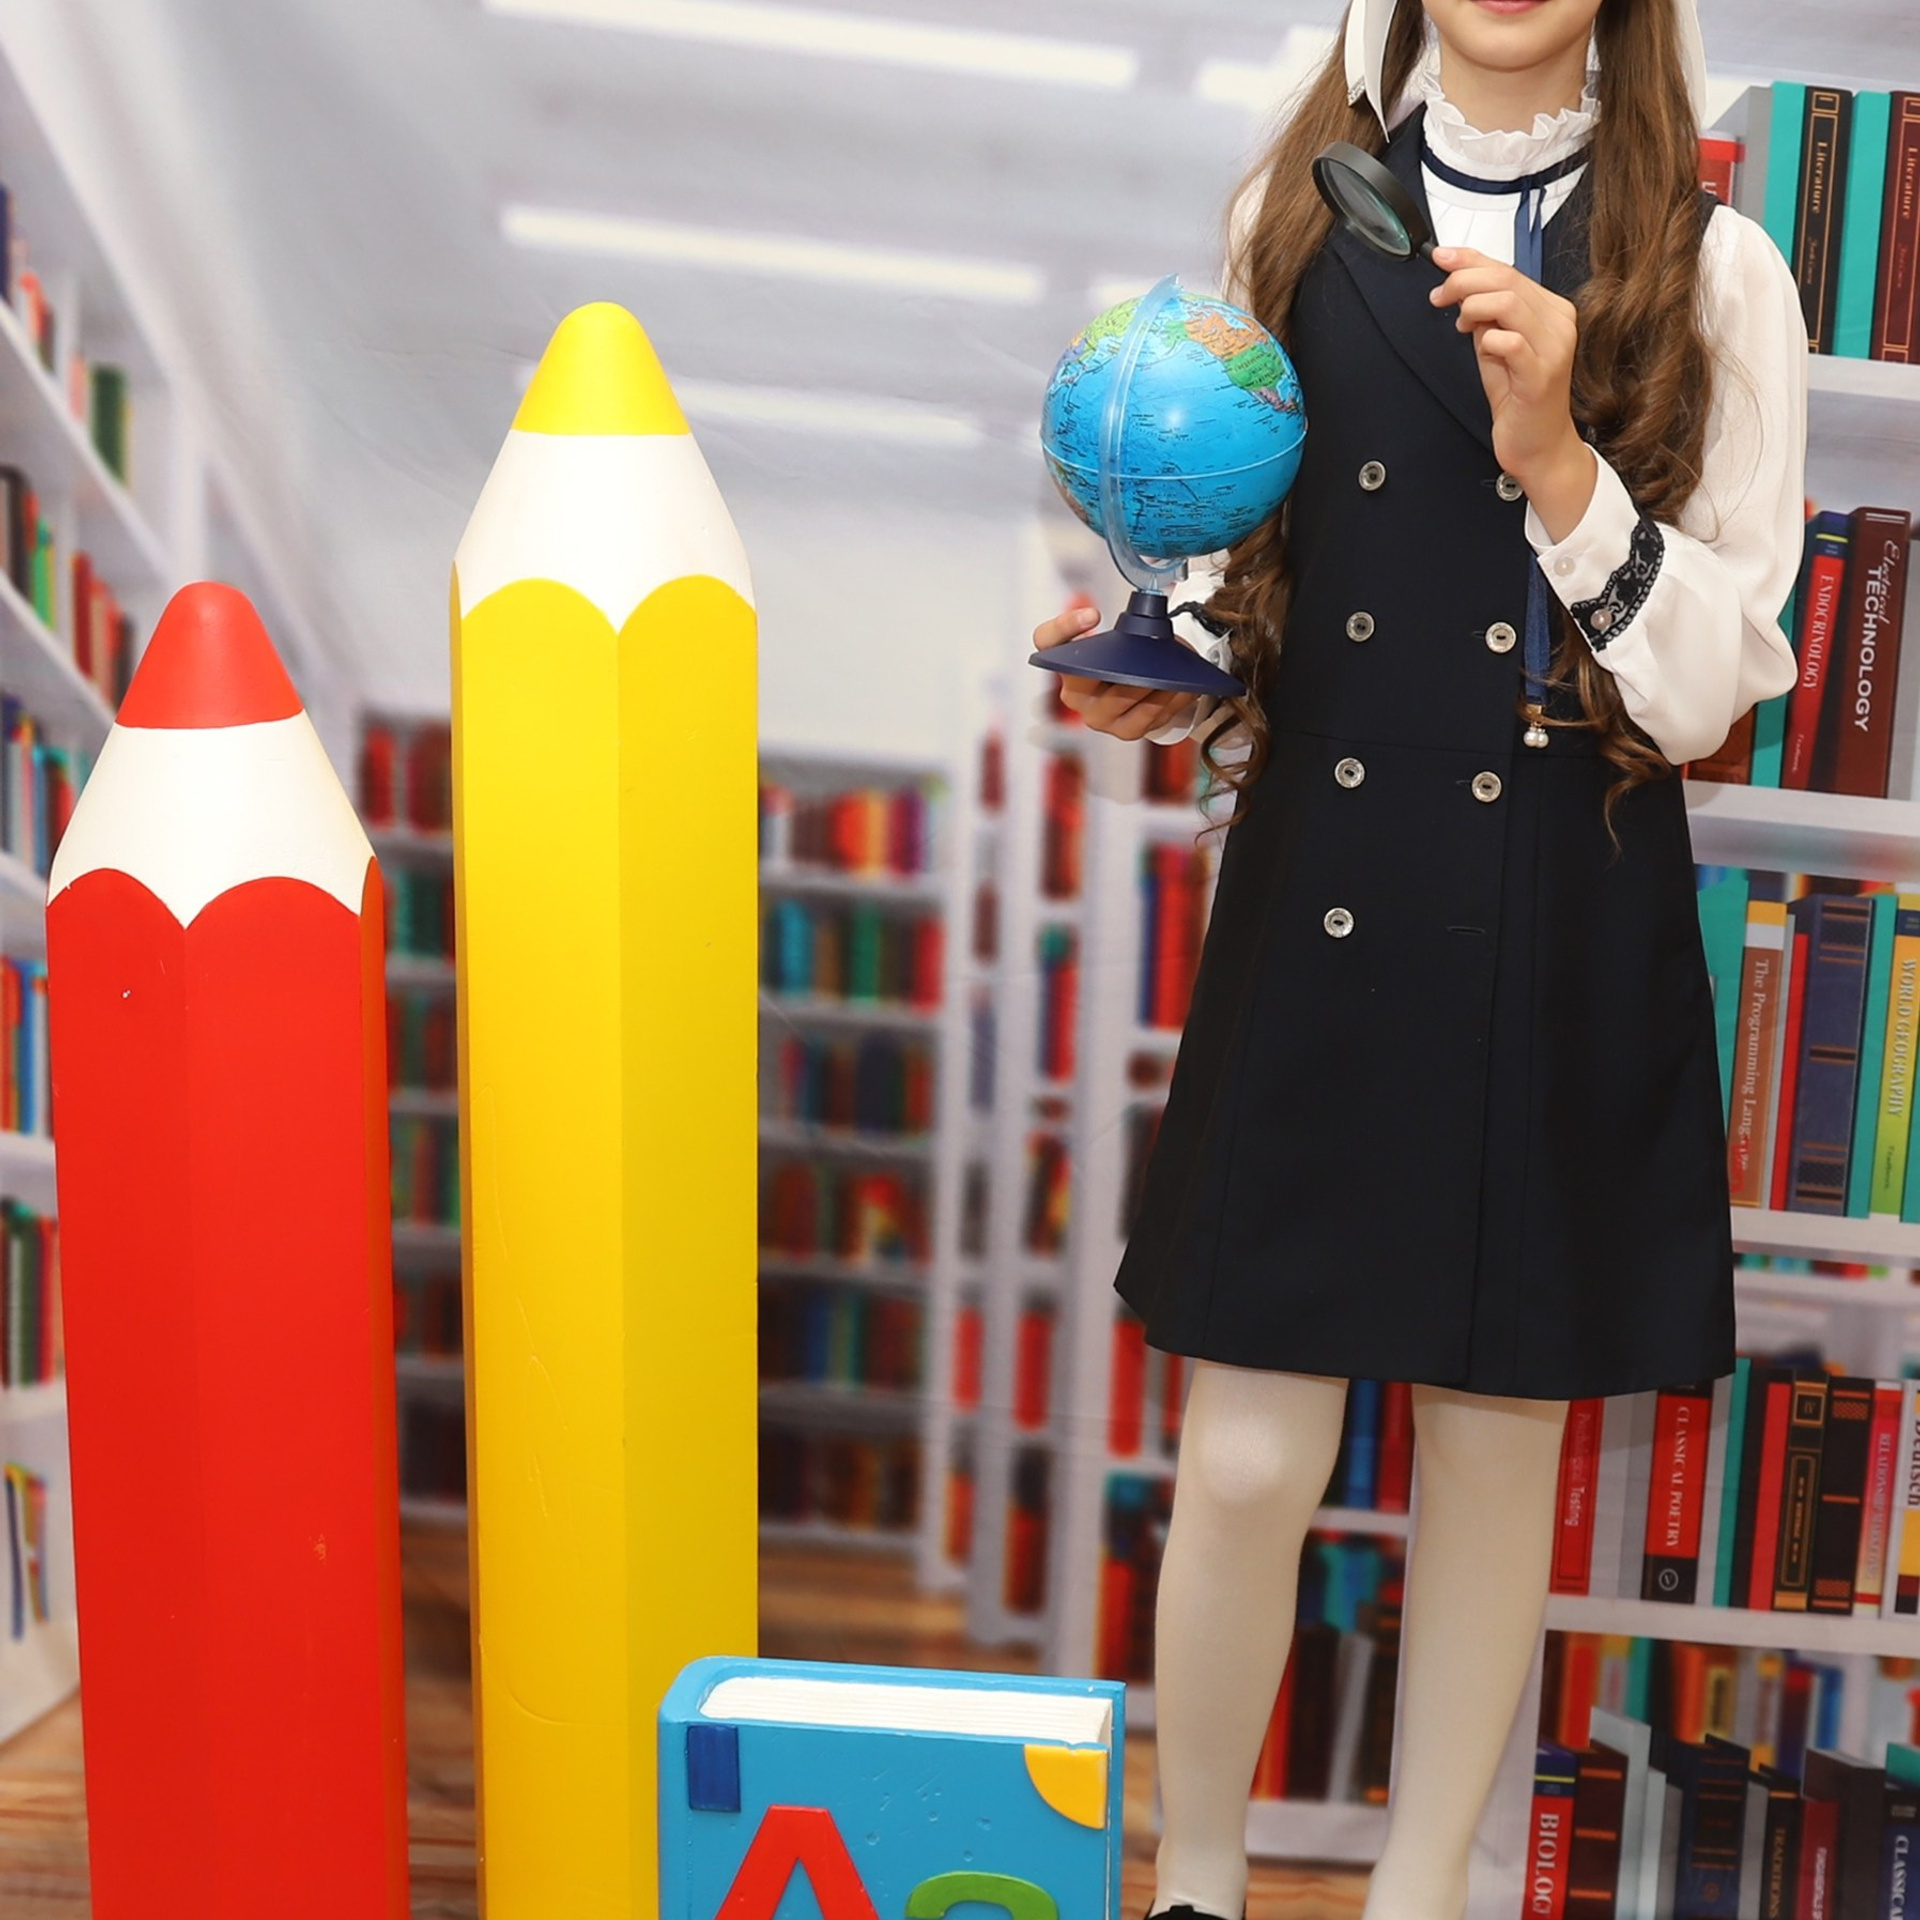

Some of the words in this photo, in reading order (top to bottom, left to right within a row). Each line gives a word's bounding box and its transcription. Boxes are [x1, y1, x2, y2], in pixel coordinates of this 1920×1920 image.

[1811, 141, 1828, 214] Literature
[1901, 147, 1918, 220] Literature
[1877, 539, 1900, 624] Electrical
[1803, 574, 1835, 691] ENDOCRINOLOGY
[1854, 565, 1882, 732] TECHNOLOGY
[1754, 959, 1769, 988] The
[1898, 958, 1917, 1017] WORLD
[1741, 991, 1767, 1094] Programming
[1887, 1018, 1911, 1118] GEOGRAPHY
[1671, 1405, 1690, 1486] CLASSICAL
[1564, 1486, 1586, 1527] Testing
[1666, 1490, 1684, 1548] POETRY
